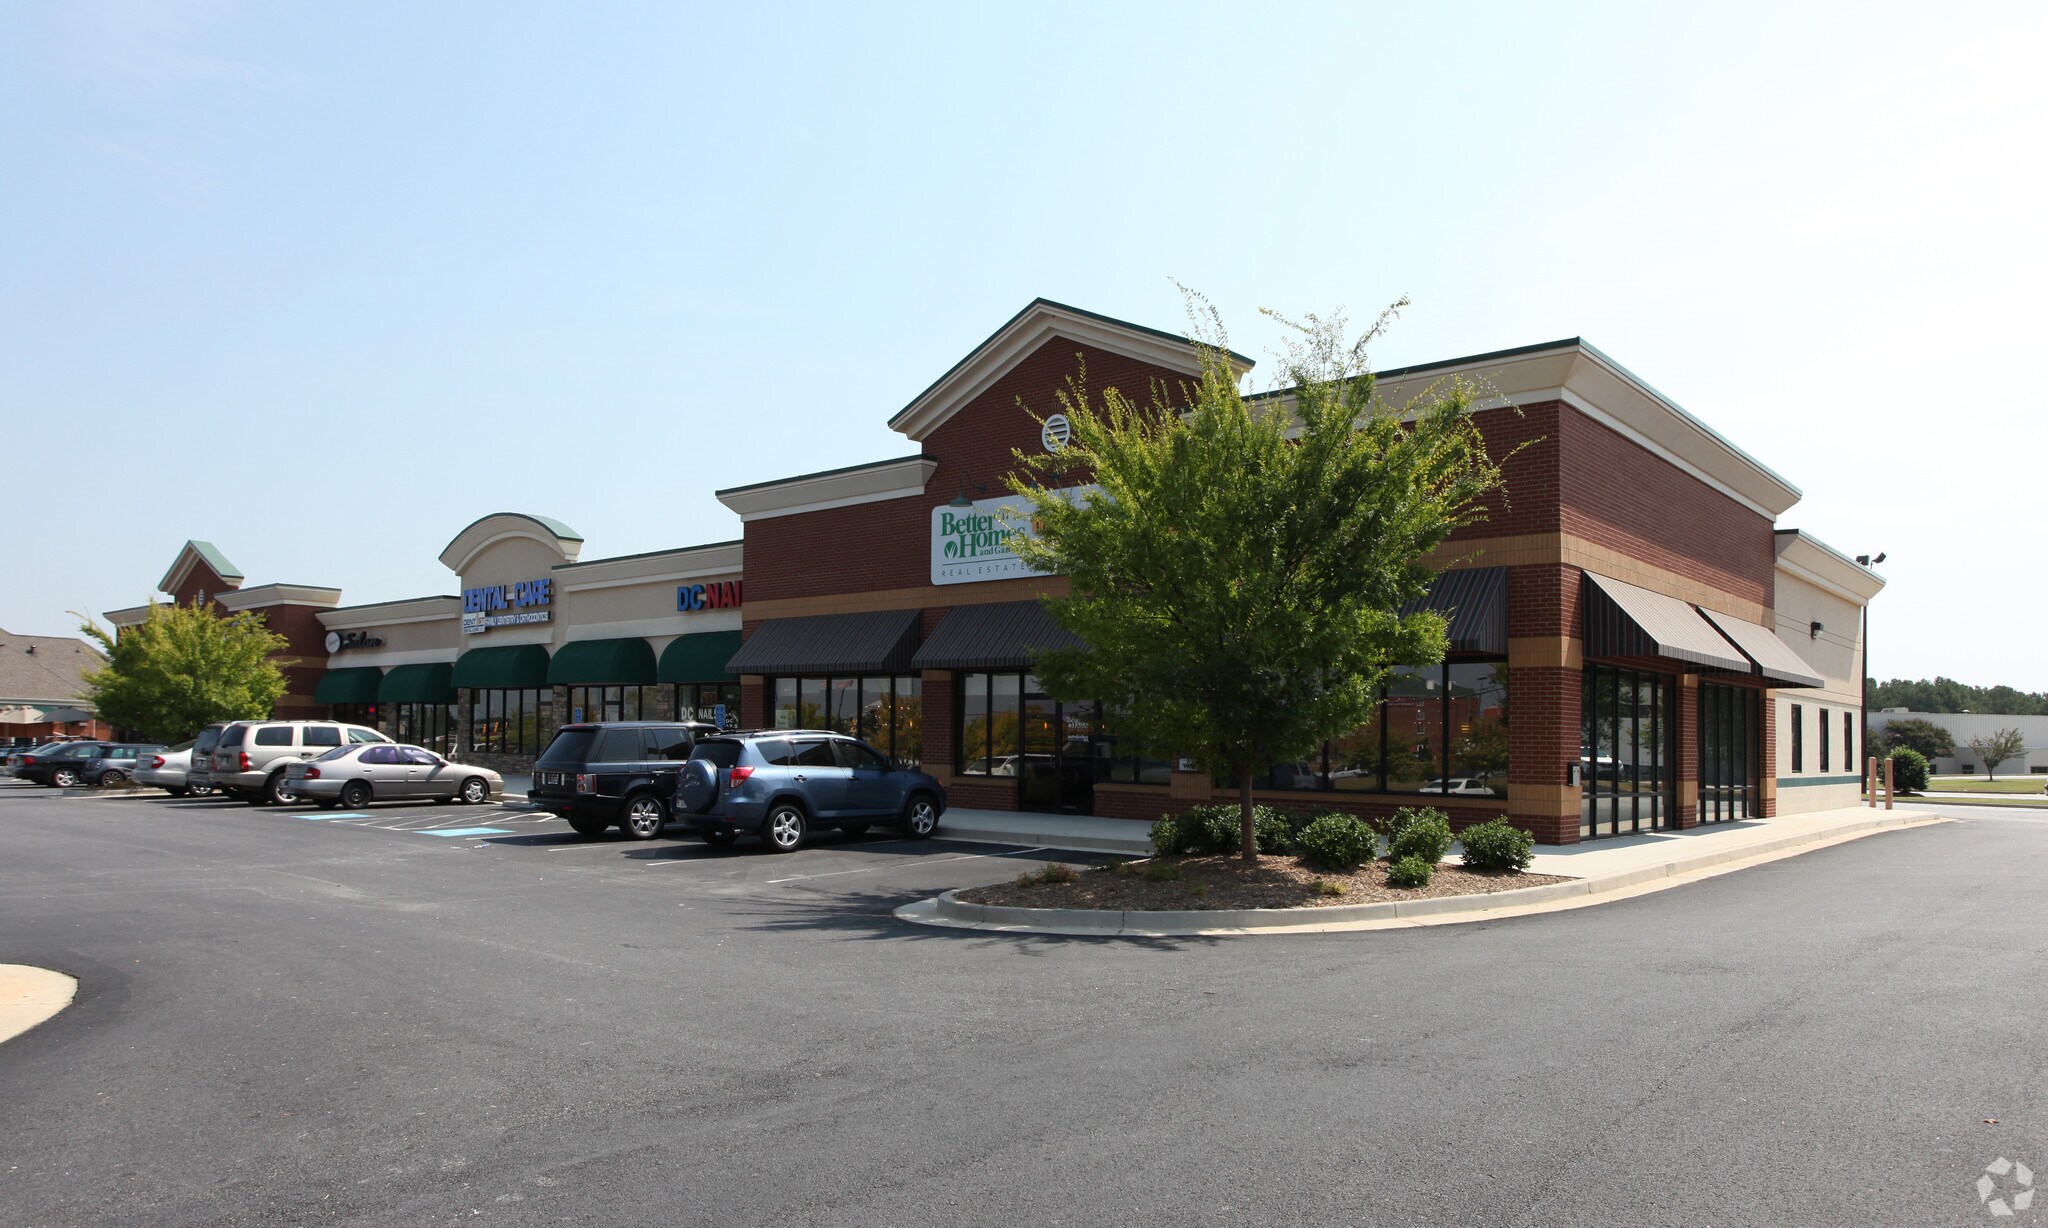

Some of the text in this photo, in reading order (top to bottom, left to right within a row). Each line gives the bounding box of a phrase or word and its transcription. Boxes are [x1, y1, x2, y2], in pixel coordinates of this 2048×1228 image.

[940, 512, 994, 537] Better
[979, 546, 994, 556] and
[941, 563, 1025, 577] REAL ESTATE
[464, 579, 551, 613] DENTAL CARE
[677, 584, 705, 612] DC
[681, 706, 694, 721] DC
